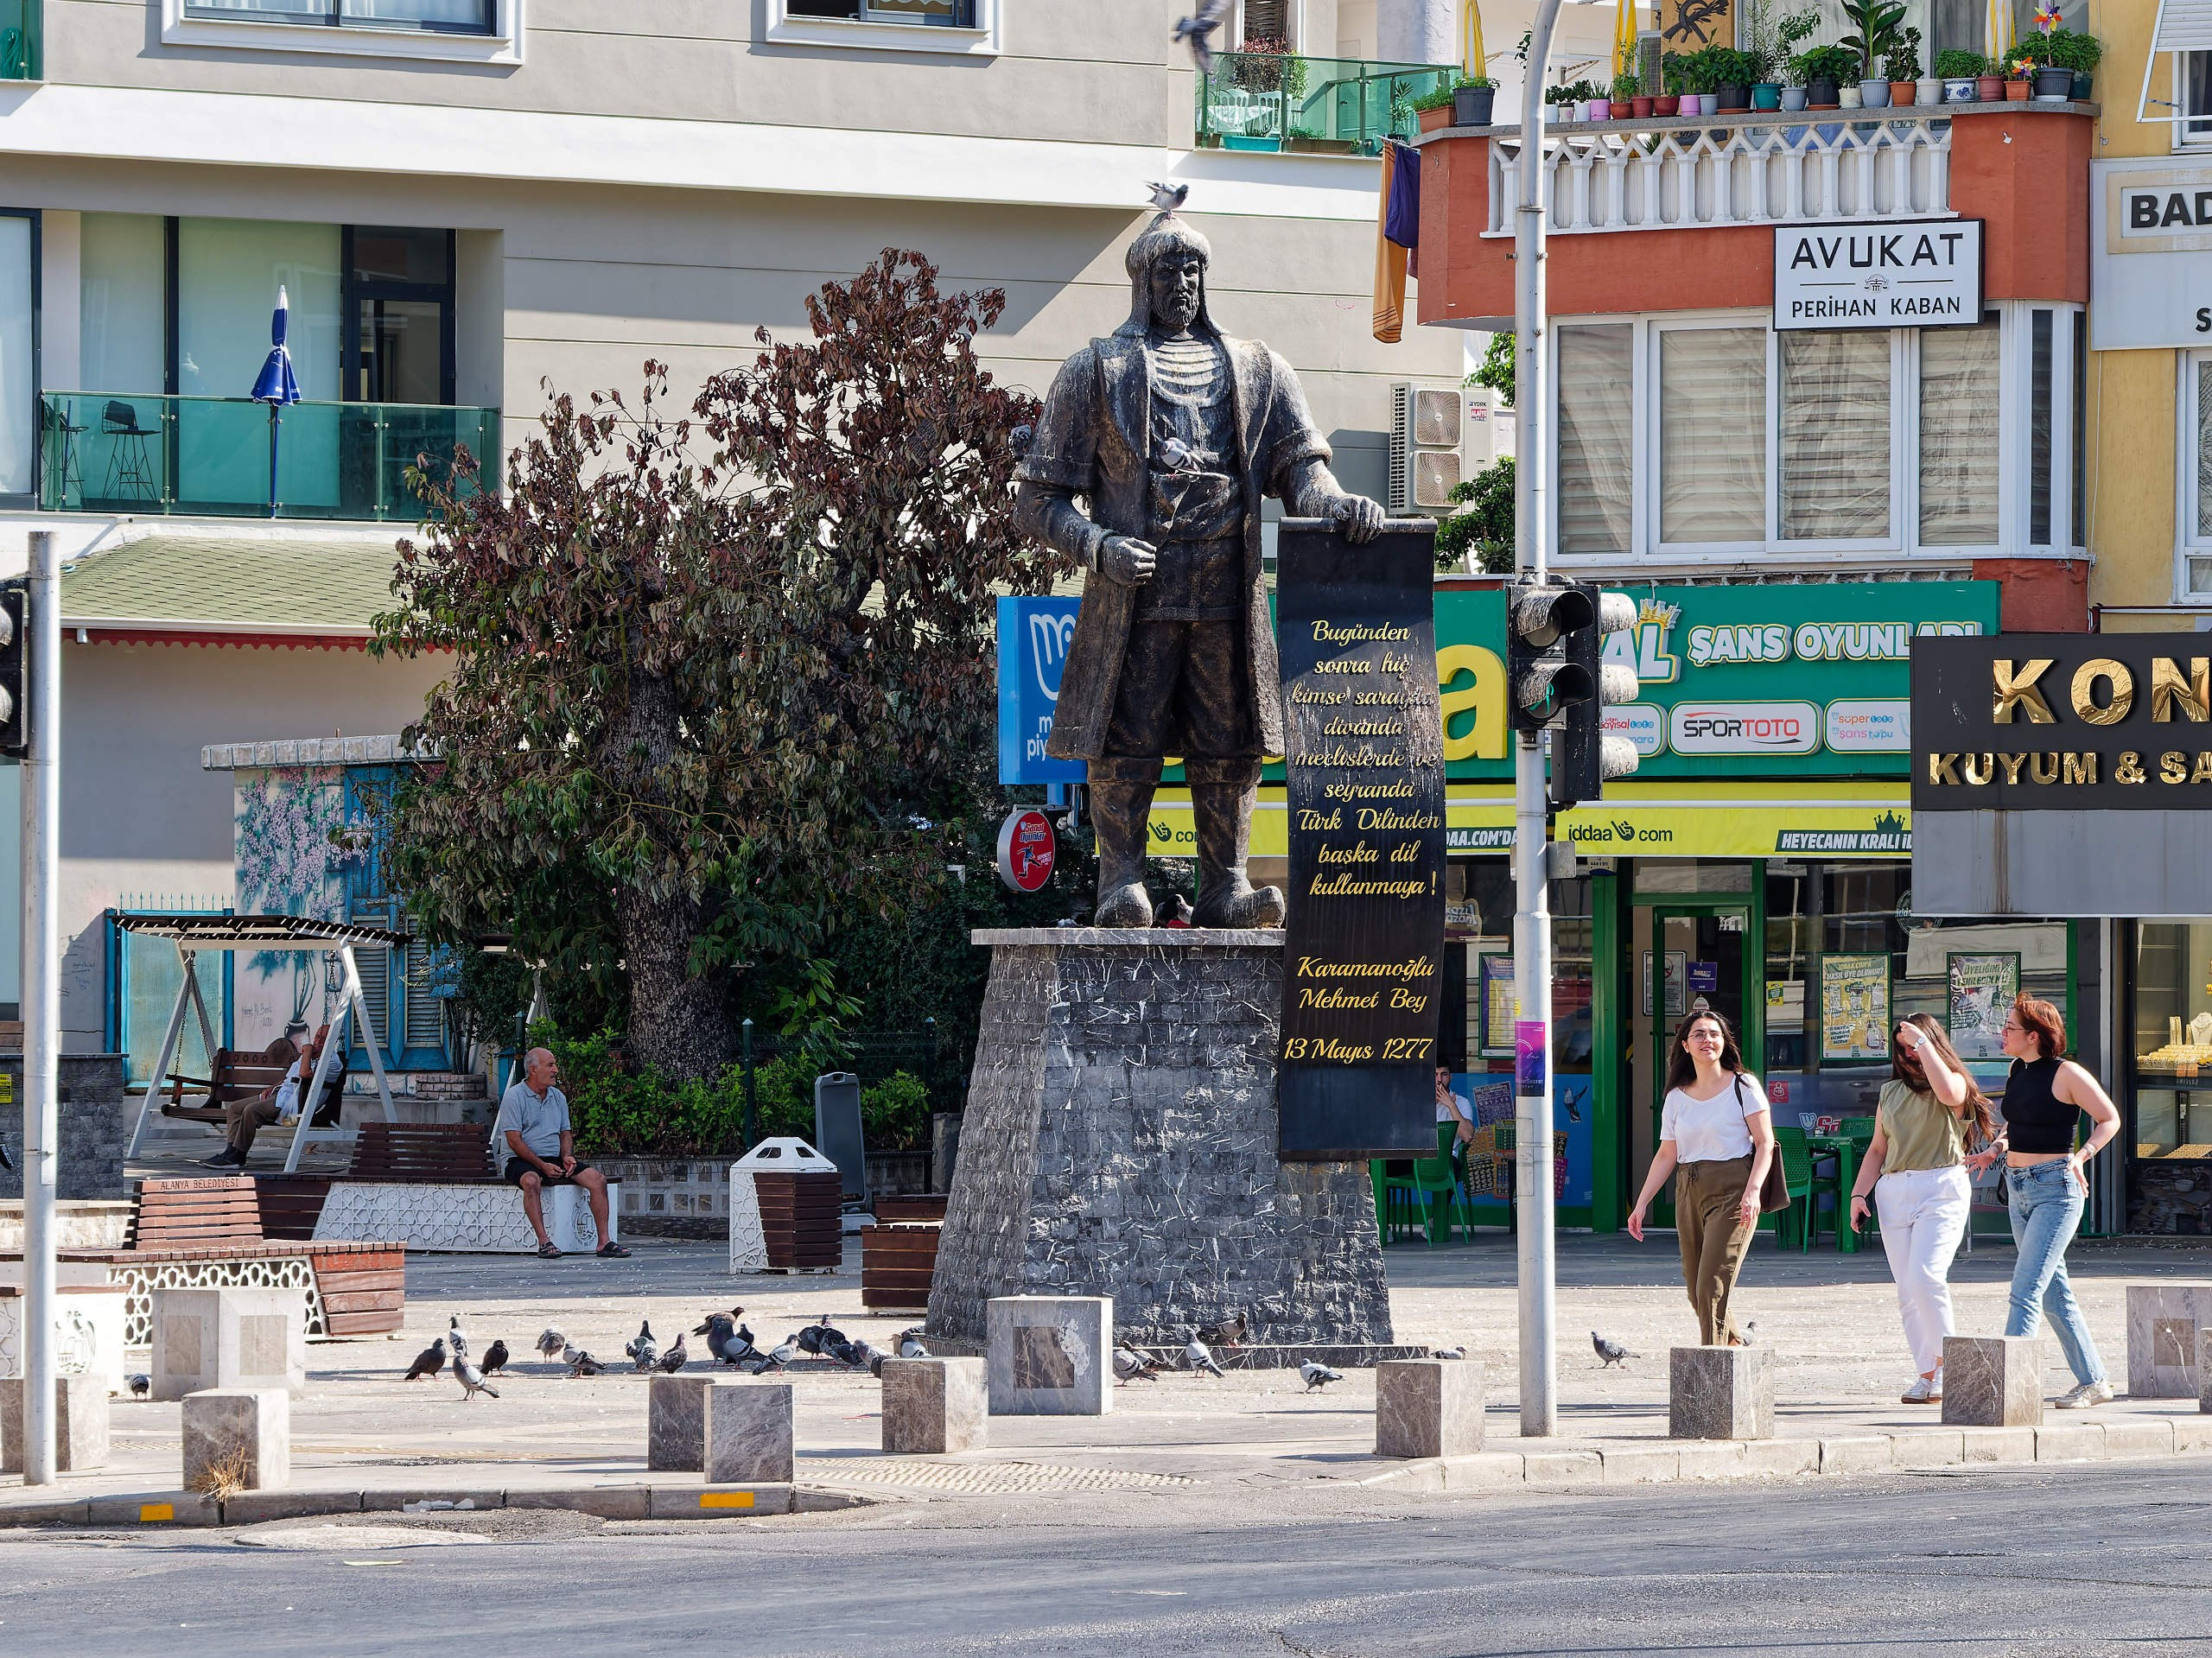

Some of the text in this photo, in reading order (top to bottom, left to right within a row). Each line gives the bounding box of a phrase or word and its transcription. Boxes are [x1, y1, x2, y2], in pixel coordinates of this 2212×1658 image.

[1790, 232, 1964, 270] AVUKAT
[1792, 295, 1961, 318] PERİHAN KABAN
[1311, 619, 1411, 646] Bugünden
[1689, 624, 1787, 664] ŞANS
[1314, 651, 1411, 678] sonra hiç
[1292, 682, 1348, 705] kimse
[1993, 657, 2210, 725] KON
[1683, 719, 1800, 737] SPORTOTO
[1929, 752, 2098, 786] KUYUM
[2114, 751, 2148, 785] &
[1324, 779, 1415, 802] seyranda
[1297, 808, 1441, 830] Türk Dilinden
[1175, 830, 1198, 842] co
[1568, 823, 1673, 842] iddaa com
[1782, 833, 1859, 849] HEYECANIN
[1859, 833, 1901, 849] KRALI
[1319, 840, 1421, 864] başka dil
[1309, 873, 1427, 899] kullanmaya
[1297, 956, 1434, 982] Karamanoğlu
[1299, 988, 1427, 1013] Mehmet Bey
[1284, 1038, 1434, 1064] 13 Mayıs 1277
[160, 1179, 189, 1191] ALANYA
